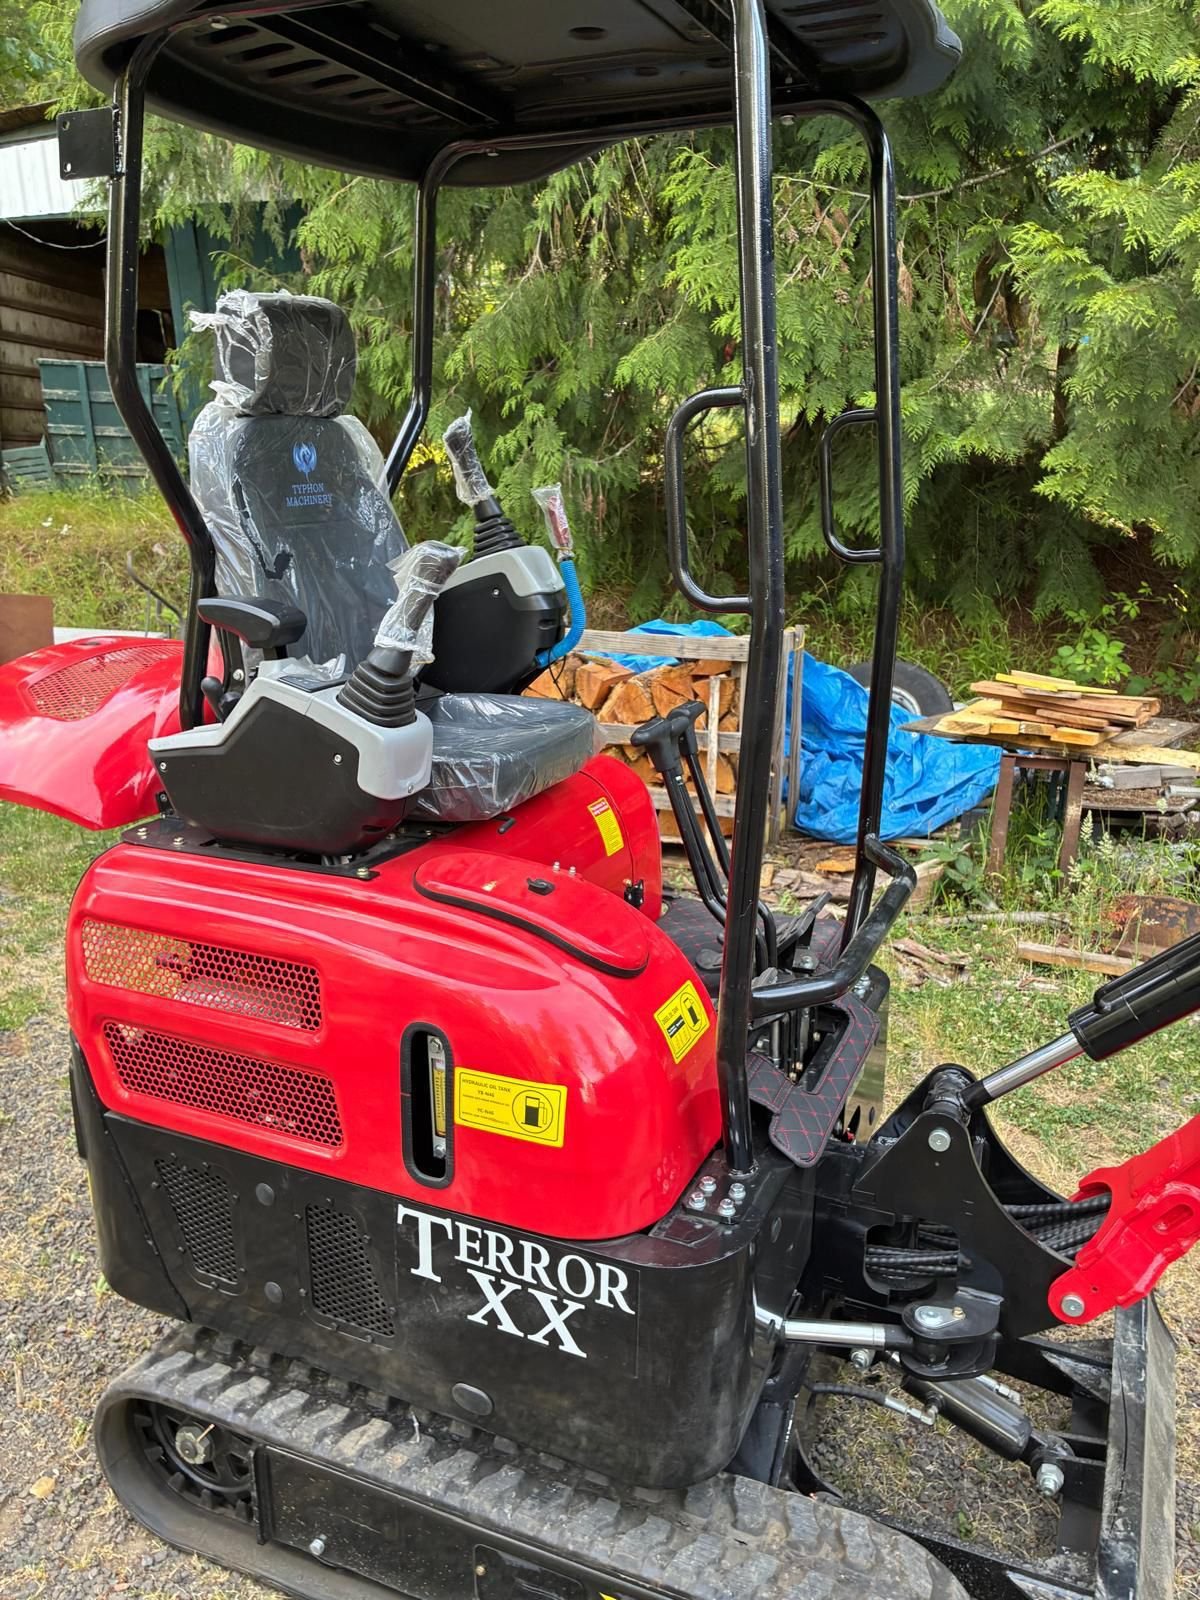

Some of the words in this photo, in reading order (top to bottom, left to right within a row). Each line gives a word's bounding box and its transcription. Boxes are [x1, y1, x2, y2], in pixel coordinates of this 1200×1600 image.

[292, 483, 325, 494] TYPHON
[286, 494, 333, 507] MACHINERY
[462, 1079, 488, 1089] HYDRAULIC
[397, 1203, 636, 1315] TERROR
[466, 1268, 588, 1358] XX
